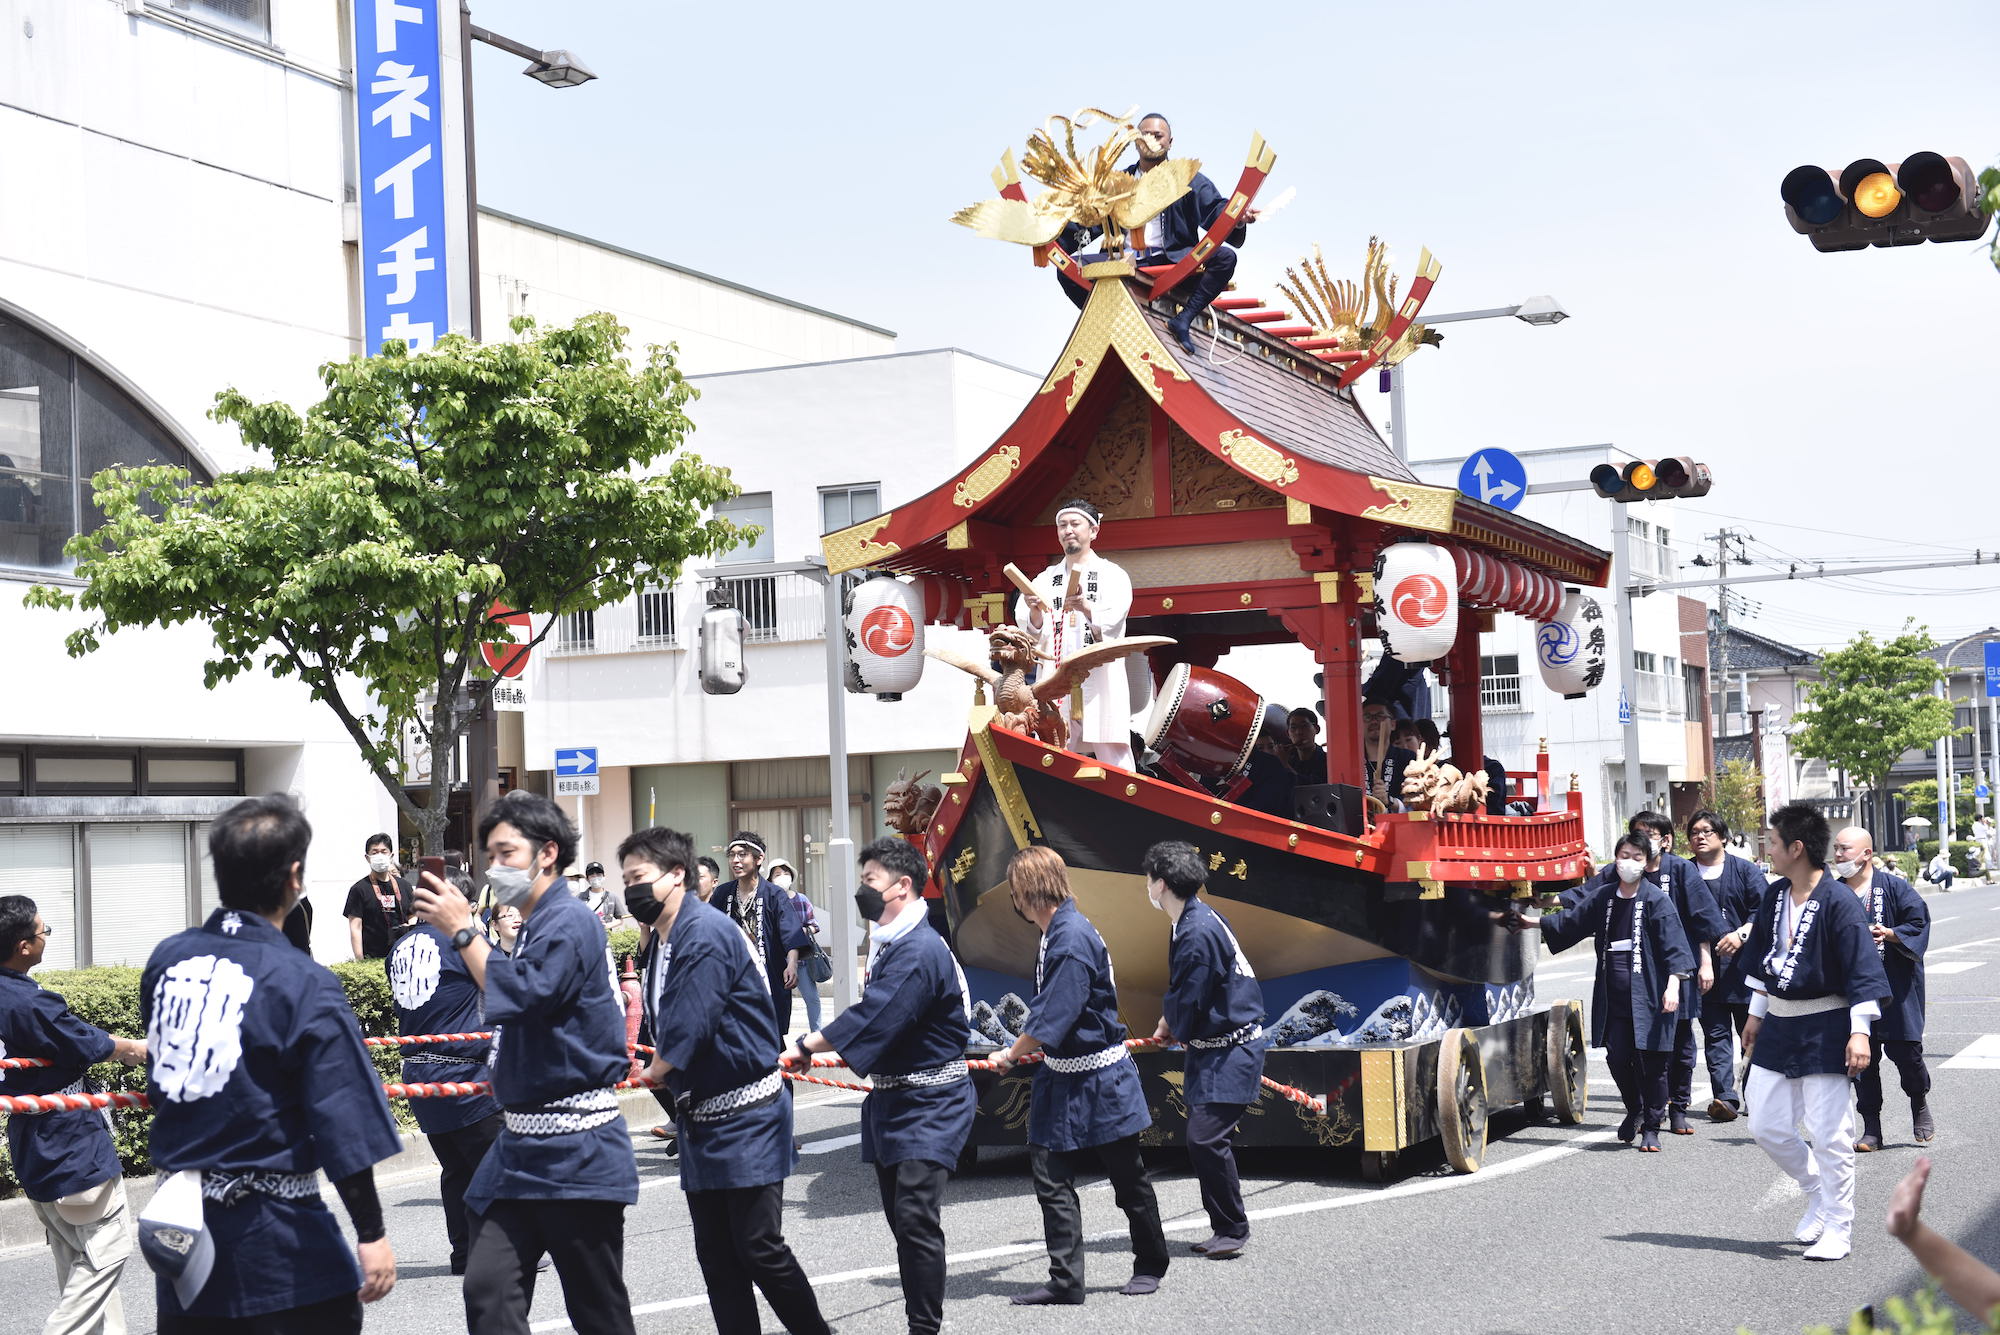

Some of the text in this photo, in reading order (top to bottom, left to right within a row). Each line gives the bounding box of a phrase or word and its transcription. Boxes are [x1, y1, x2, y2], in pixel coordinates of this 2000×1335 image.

[494, 688, 527, 704] 軽車両を除く
[558, 780, 596, 792] 軽車両を除く
